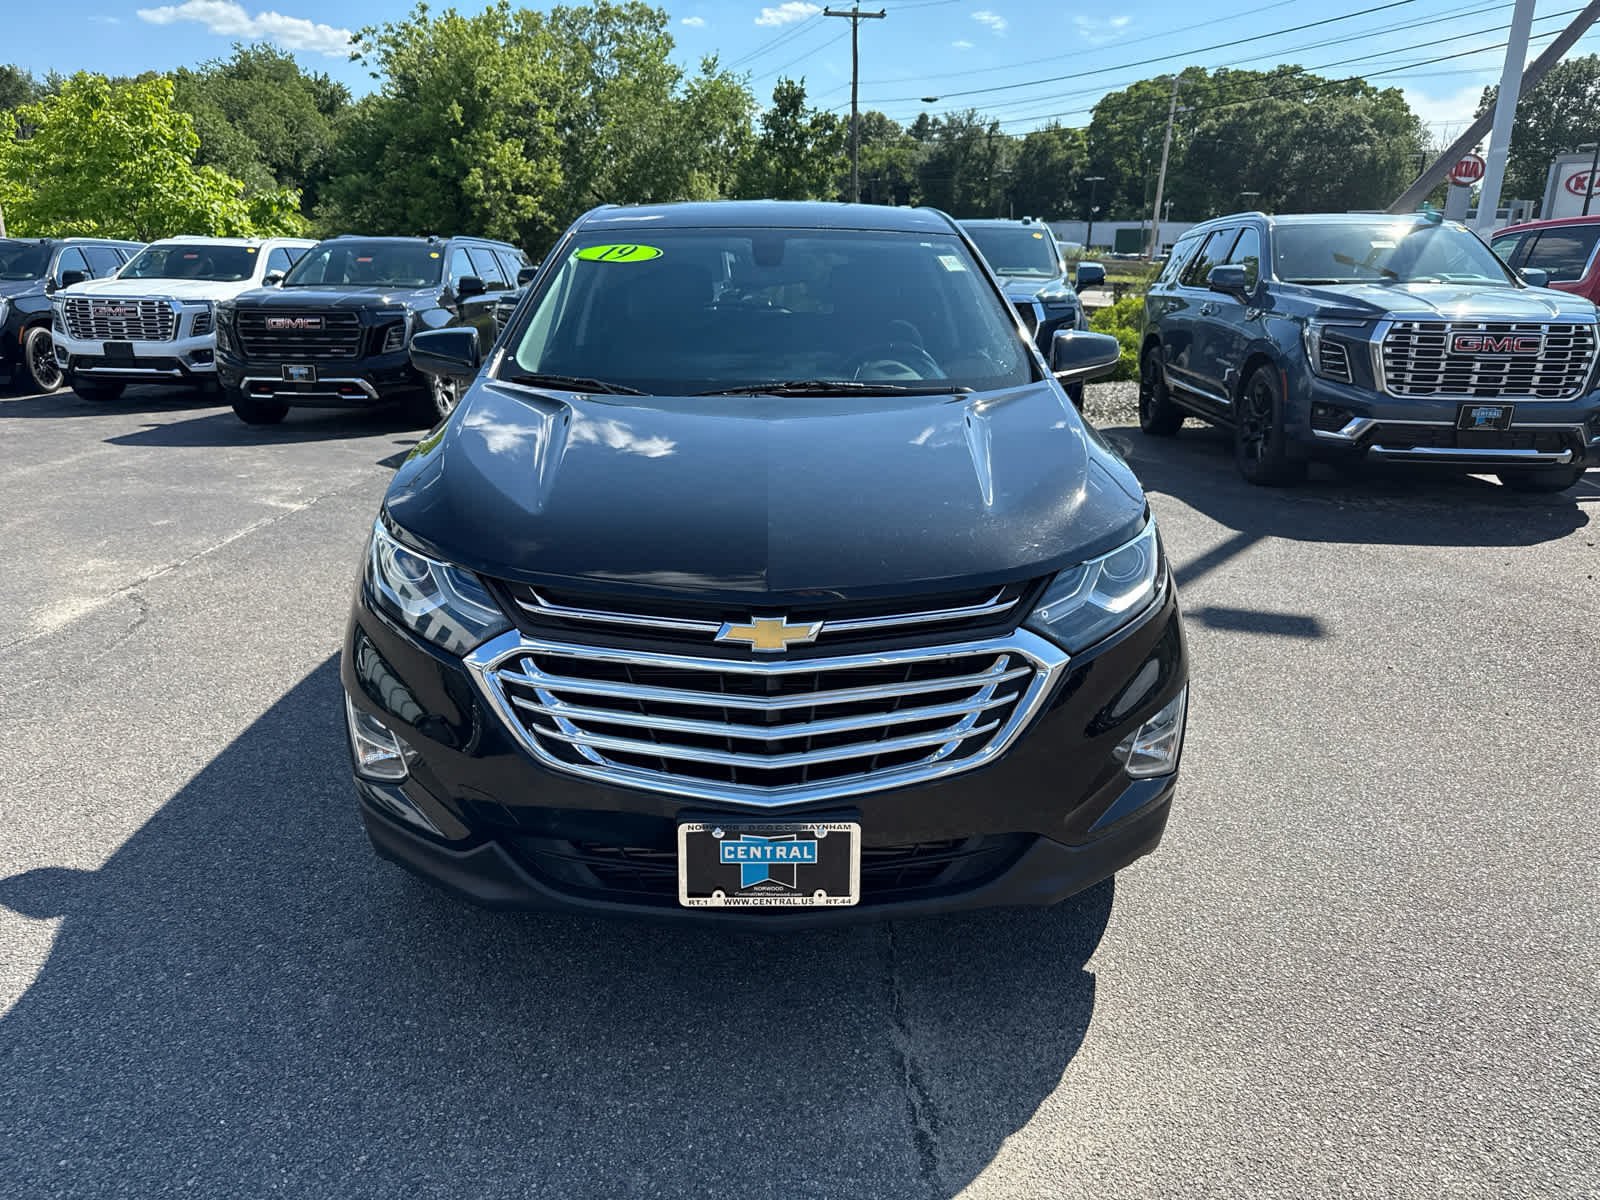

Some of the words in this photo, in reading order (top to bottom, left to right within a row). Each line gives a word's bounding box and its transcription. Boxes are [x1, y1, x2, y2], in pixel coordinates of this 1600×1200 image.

[1454, 160, 1480, 178] KIA
[597, 245, 639, 260] 19
[93, 306, 136, 316] GMC
[267, 317, 321, 329] GMC
[1455, 335, 1540, 352] GMC
[724, 846, 813, 859] CENTRAL
[724, 898, 814, 906] WWW.CENTRAL.US
[825, 898, 852, 906] RT.44
